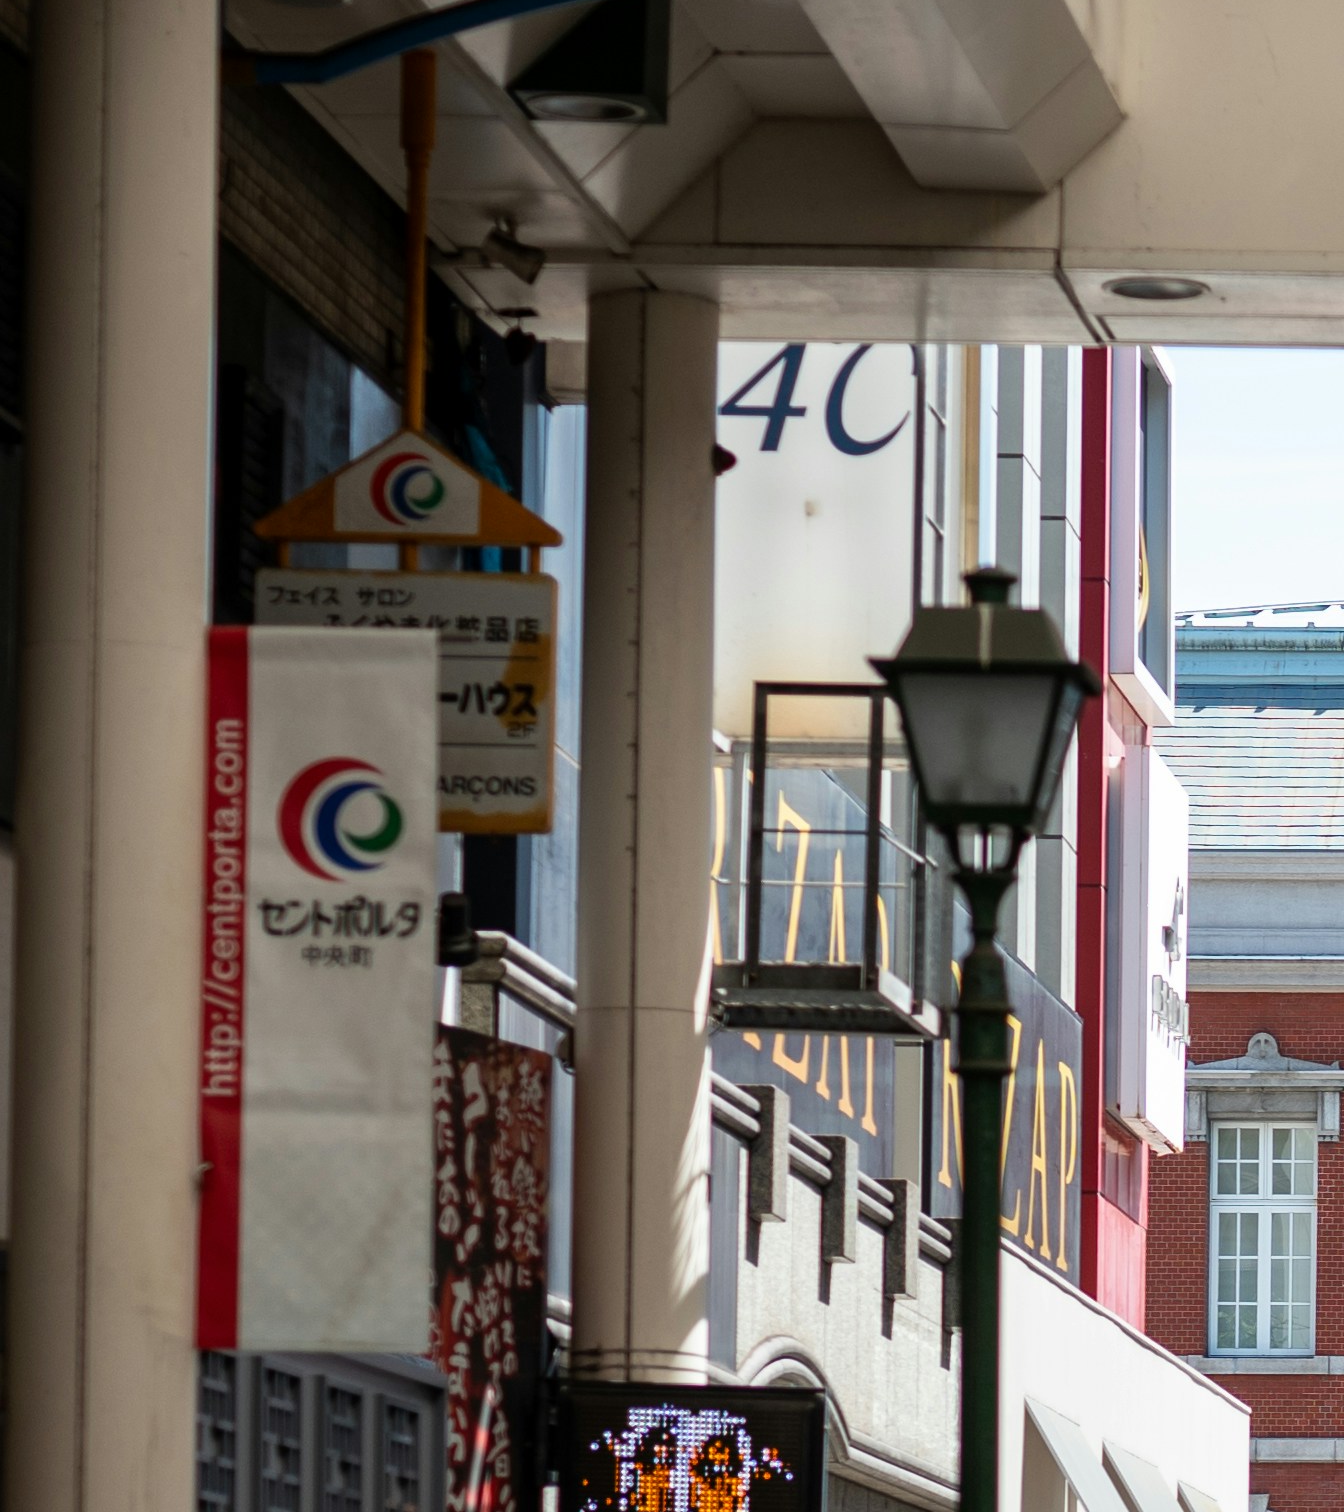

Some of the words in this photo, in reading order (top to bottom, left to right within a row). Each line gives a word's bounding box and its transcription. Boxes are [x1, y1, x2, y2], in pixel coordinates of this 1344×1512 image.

[268, 586, 340, 605] フェイス
[356, 588, 414, 606] サロン
[440, 683, 537, 718] ーハウス
[507, 722, 535, 738] 2F
[438, 776, 536, 802] ARÇONS
[201, 718, 244, 1097] http://centporta.com
[257, 896, 421, 938] セントポルタ
[302, 944, 372, 968] 中央町
